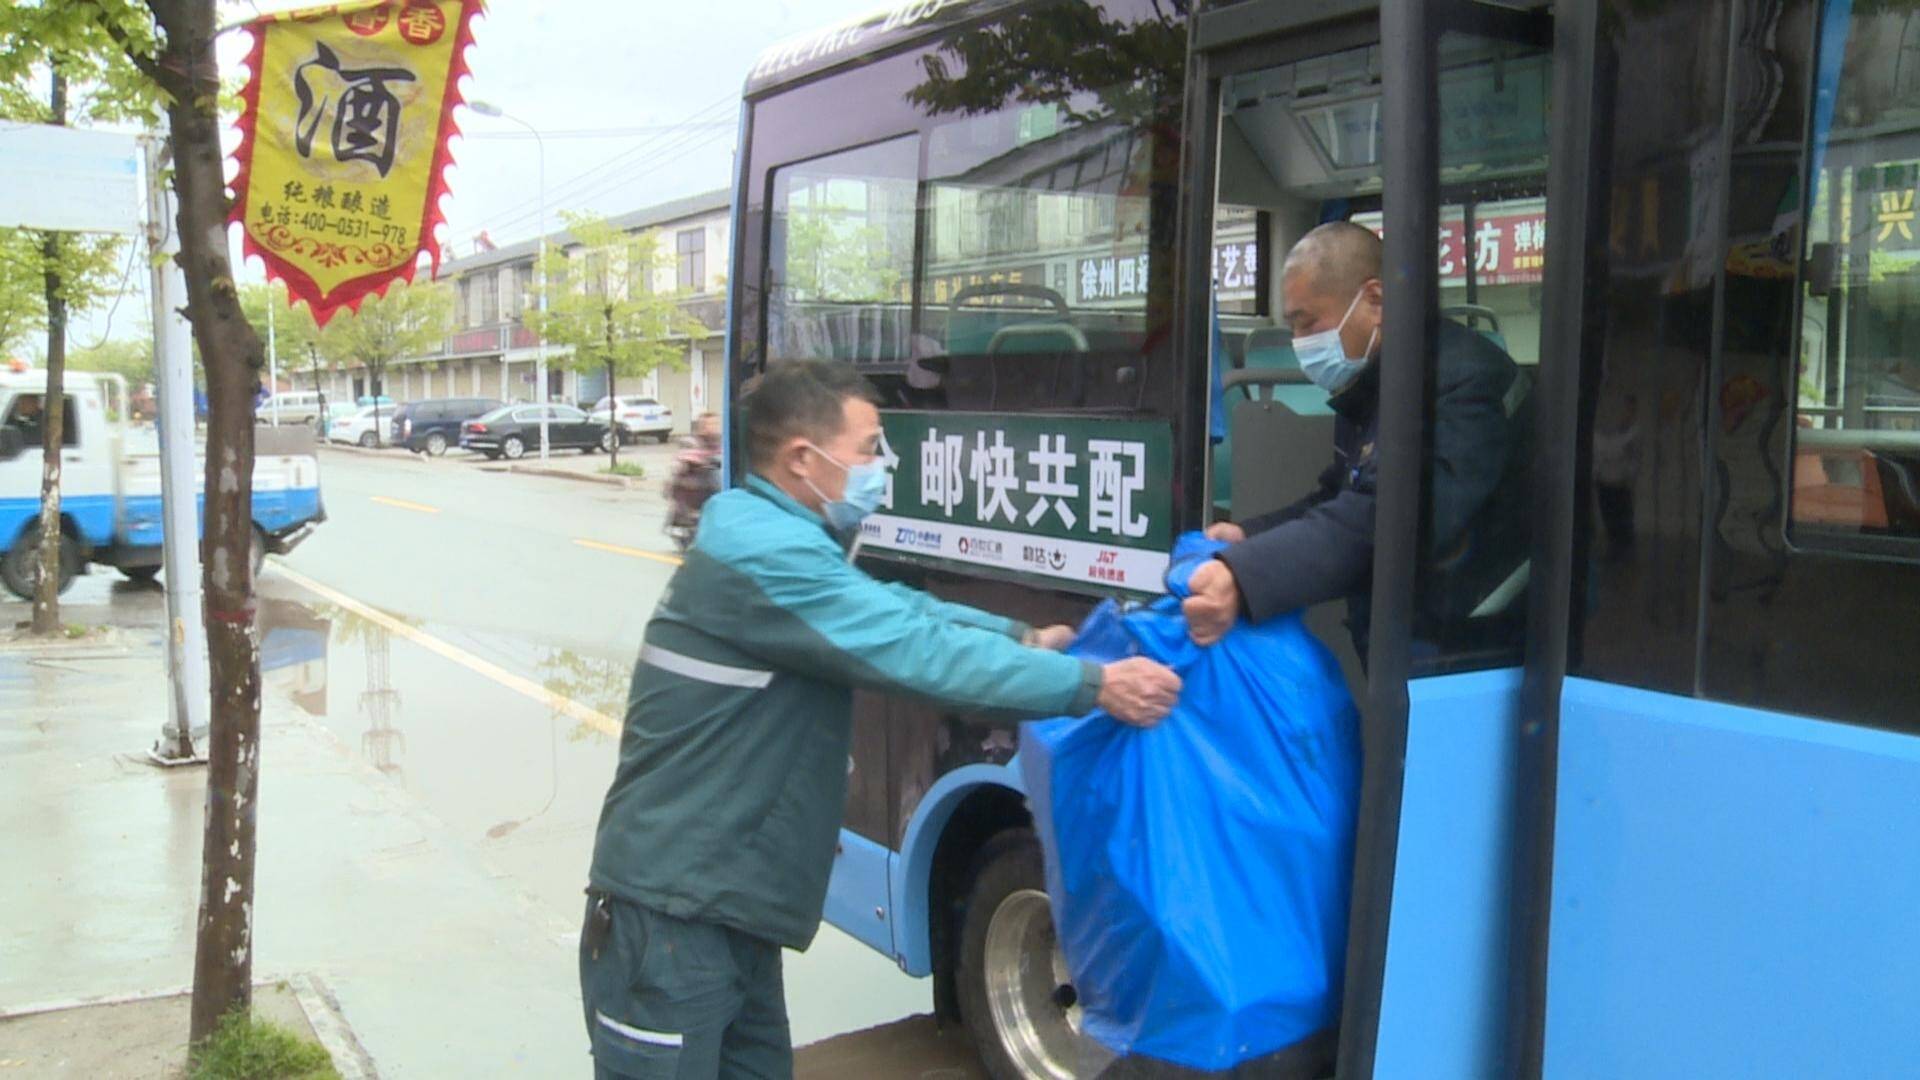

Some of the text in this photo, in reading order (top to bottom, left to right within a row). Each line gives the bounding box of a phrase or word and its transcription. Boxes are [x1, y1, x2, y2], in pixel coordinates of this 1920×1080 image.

[401, 7, 442, 40] 香
[294, 40, 415, 178] 酒
[284, 180, 392, 221] 纯粮酿造
[1878, 189, 1915, 243] 兴
[920, 428, 1149, 538] 邮快共配
